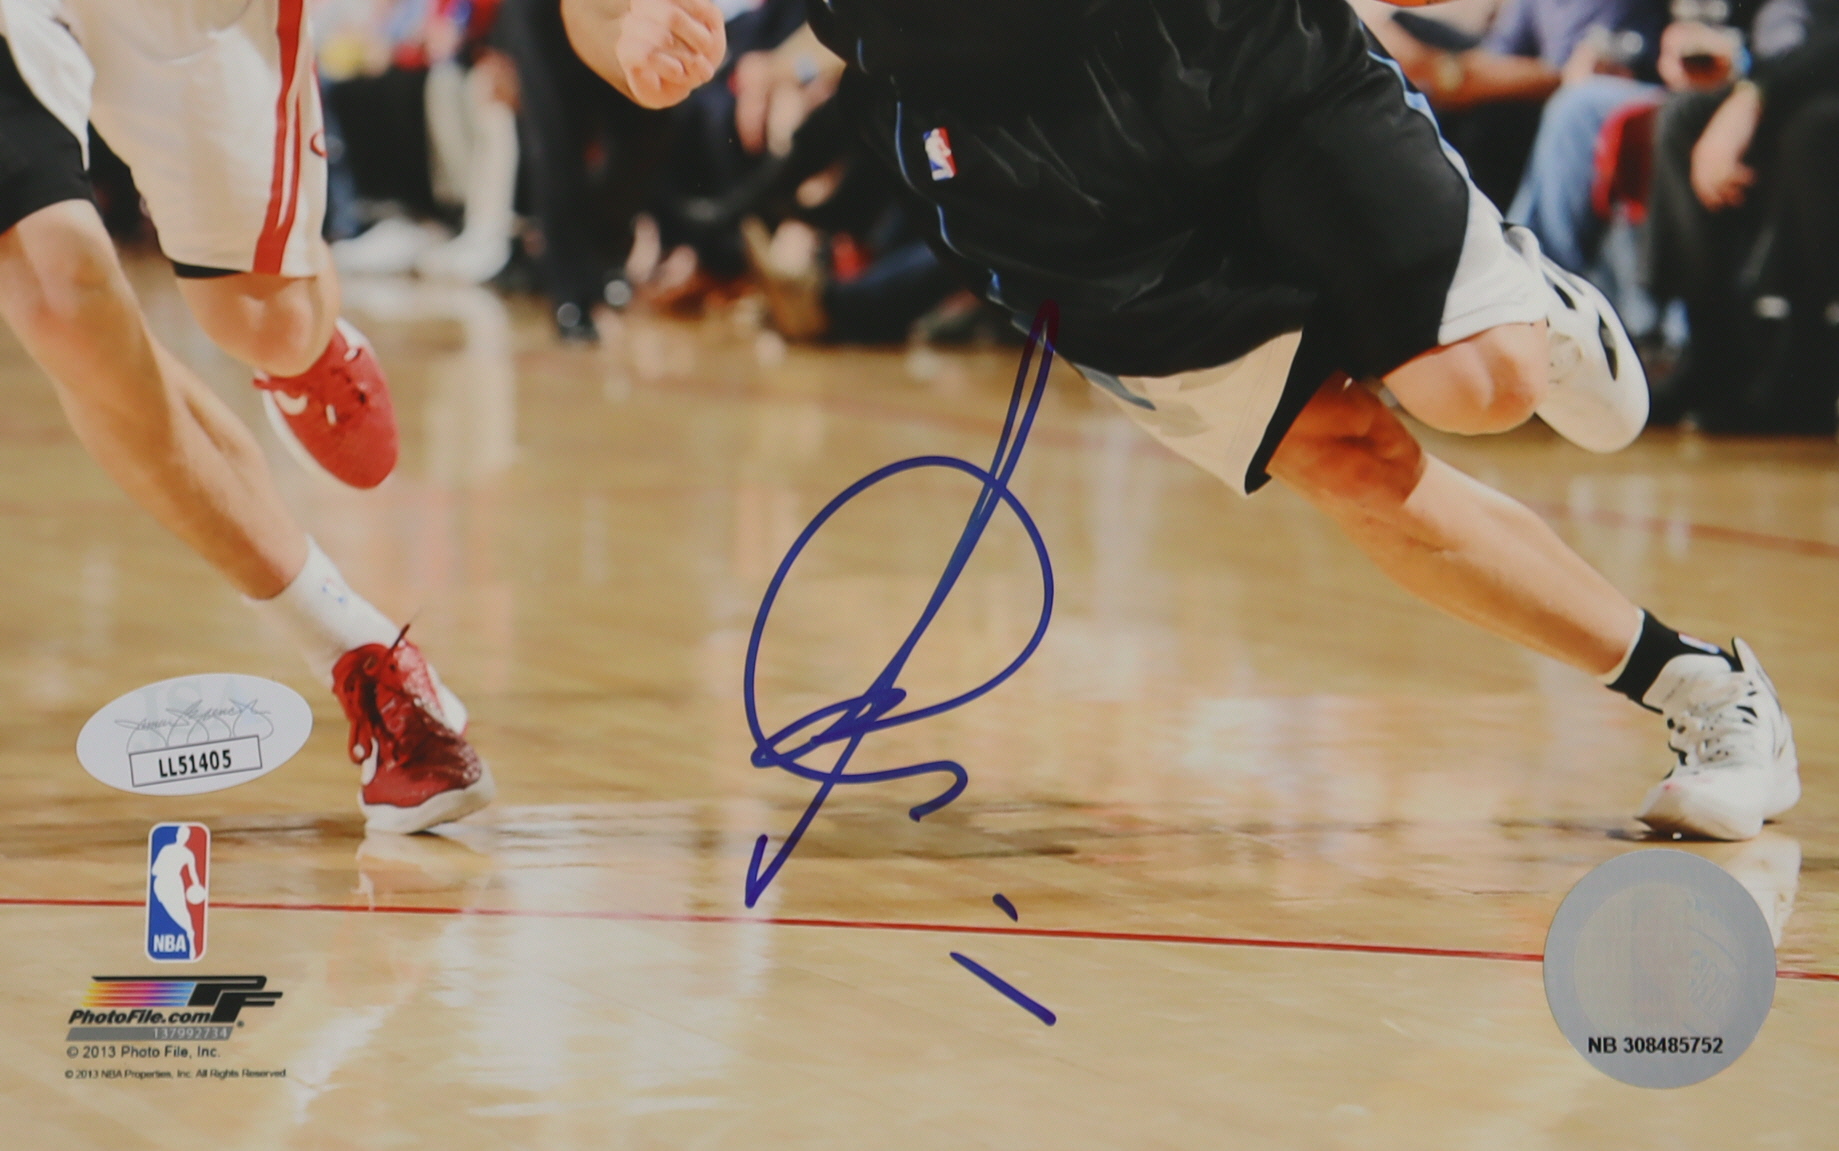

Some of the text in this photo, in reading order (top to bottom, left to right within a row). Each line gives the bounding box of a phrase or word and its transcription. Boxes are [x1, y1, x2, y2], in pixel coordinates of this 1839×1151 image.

[158, 749, 232, 778] LL51405
[1588, 1036, 1724, 1054] NB 308485752
